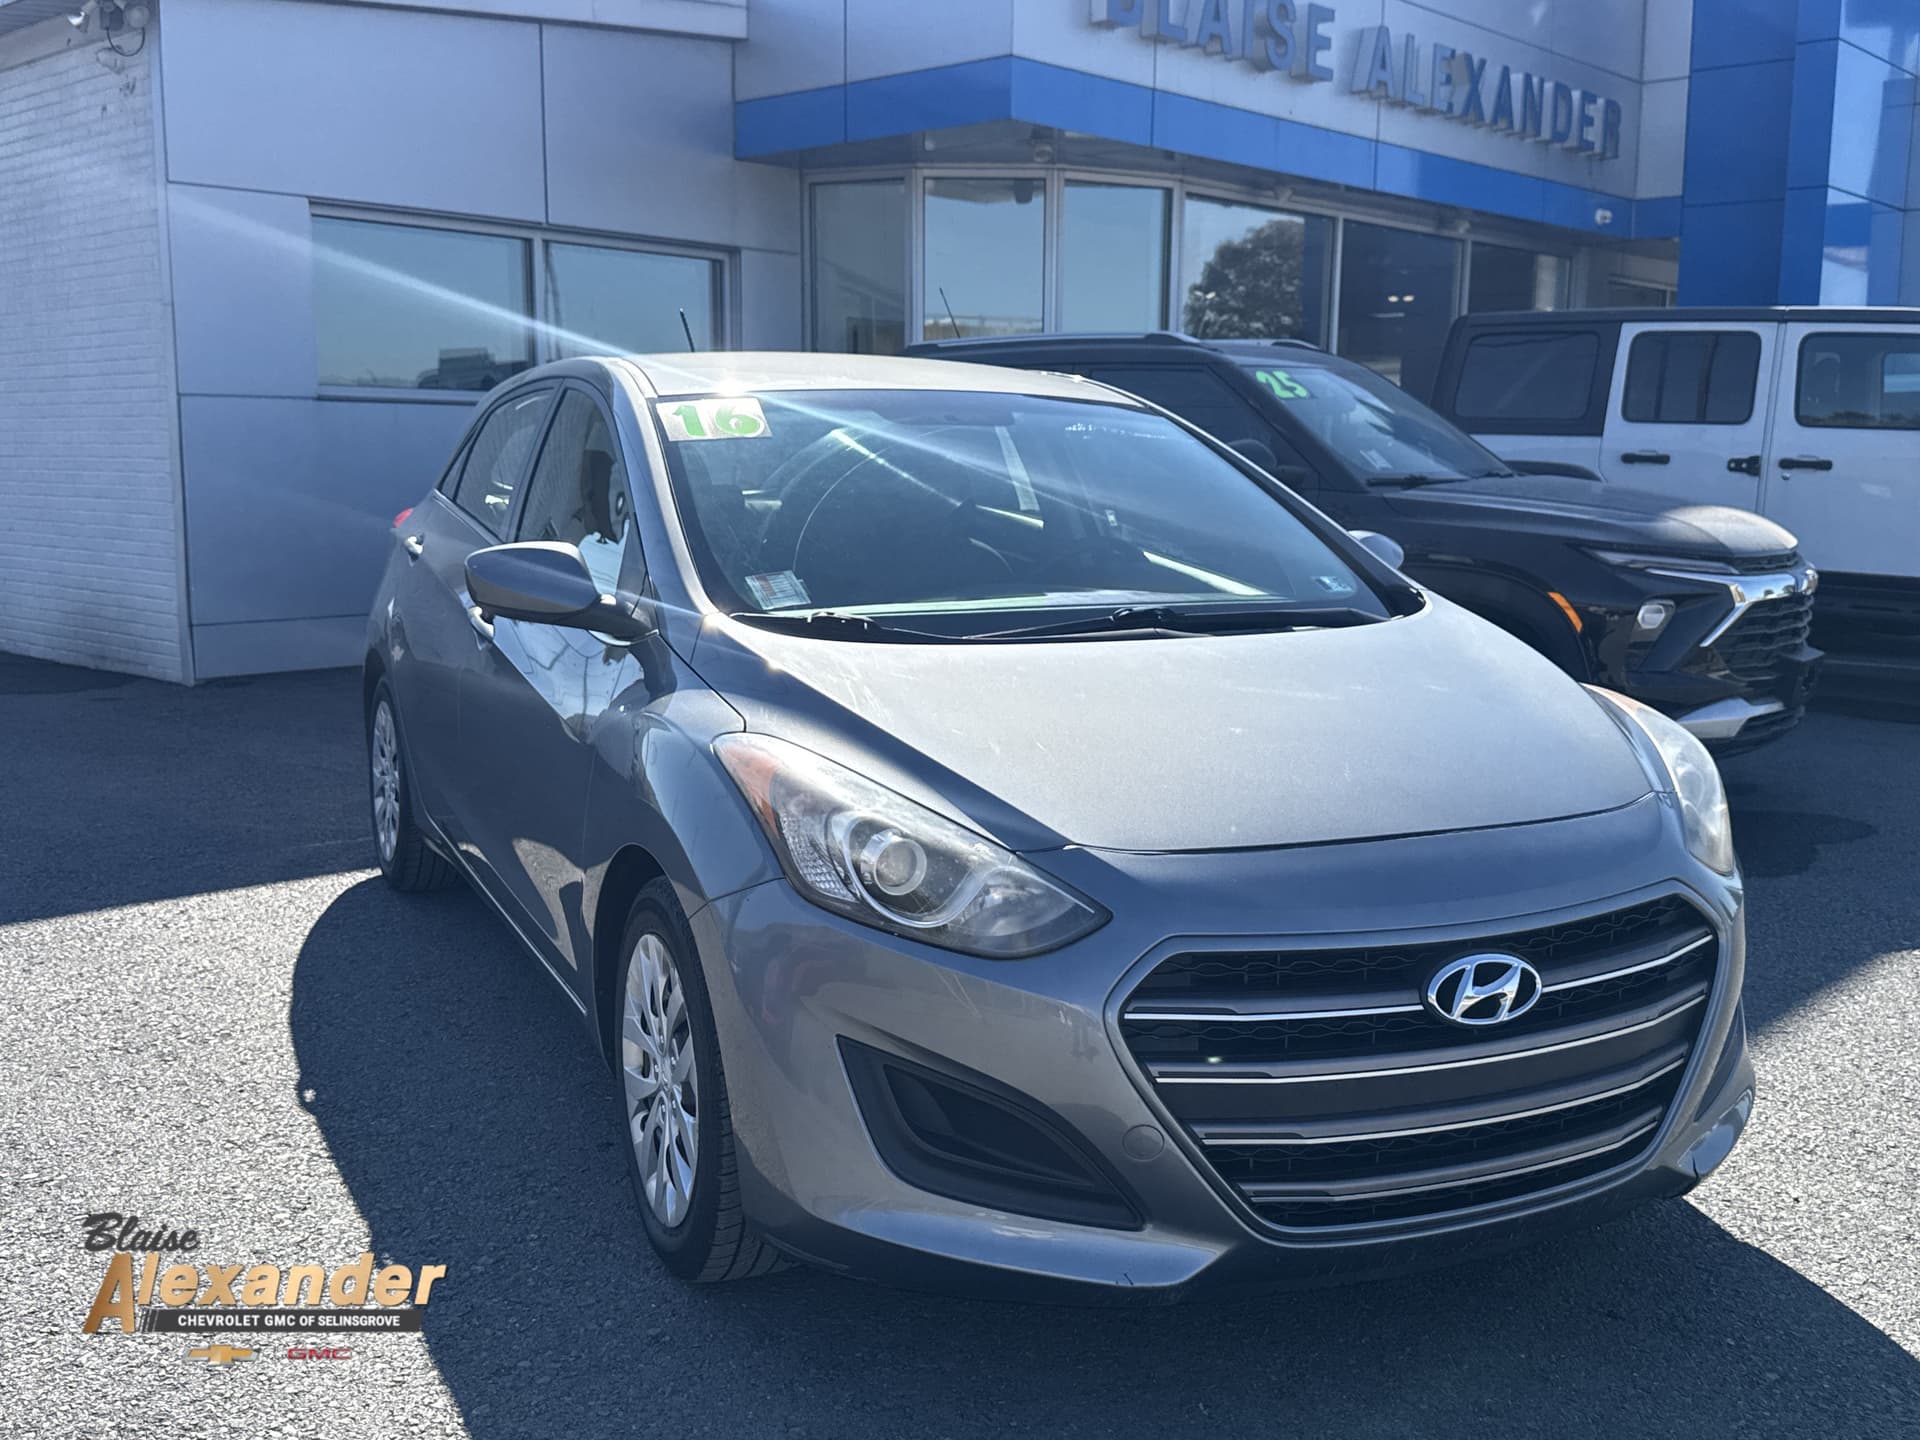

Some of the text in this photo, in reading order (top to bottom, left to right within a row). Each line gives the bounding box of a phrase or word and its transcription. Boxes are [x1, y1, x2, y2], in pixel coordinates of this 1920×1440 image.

[1356, 25, 1622, 159] ALEXANDER
[1254, 369, 1309, 399] 25
[671, 403, 765, 437] 16
